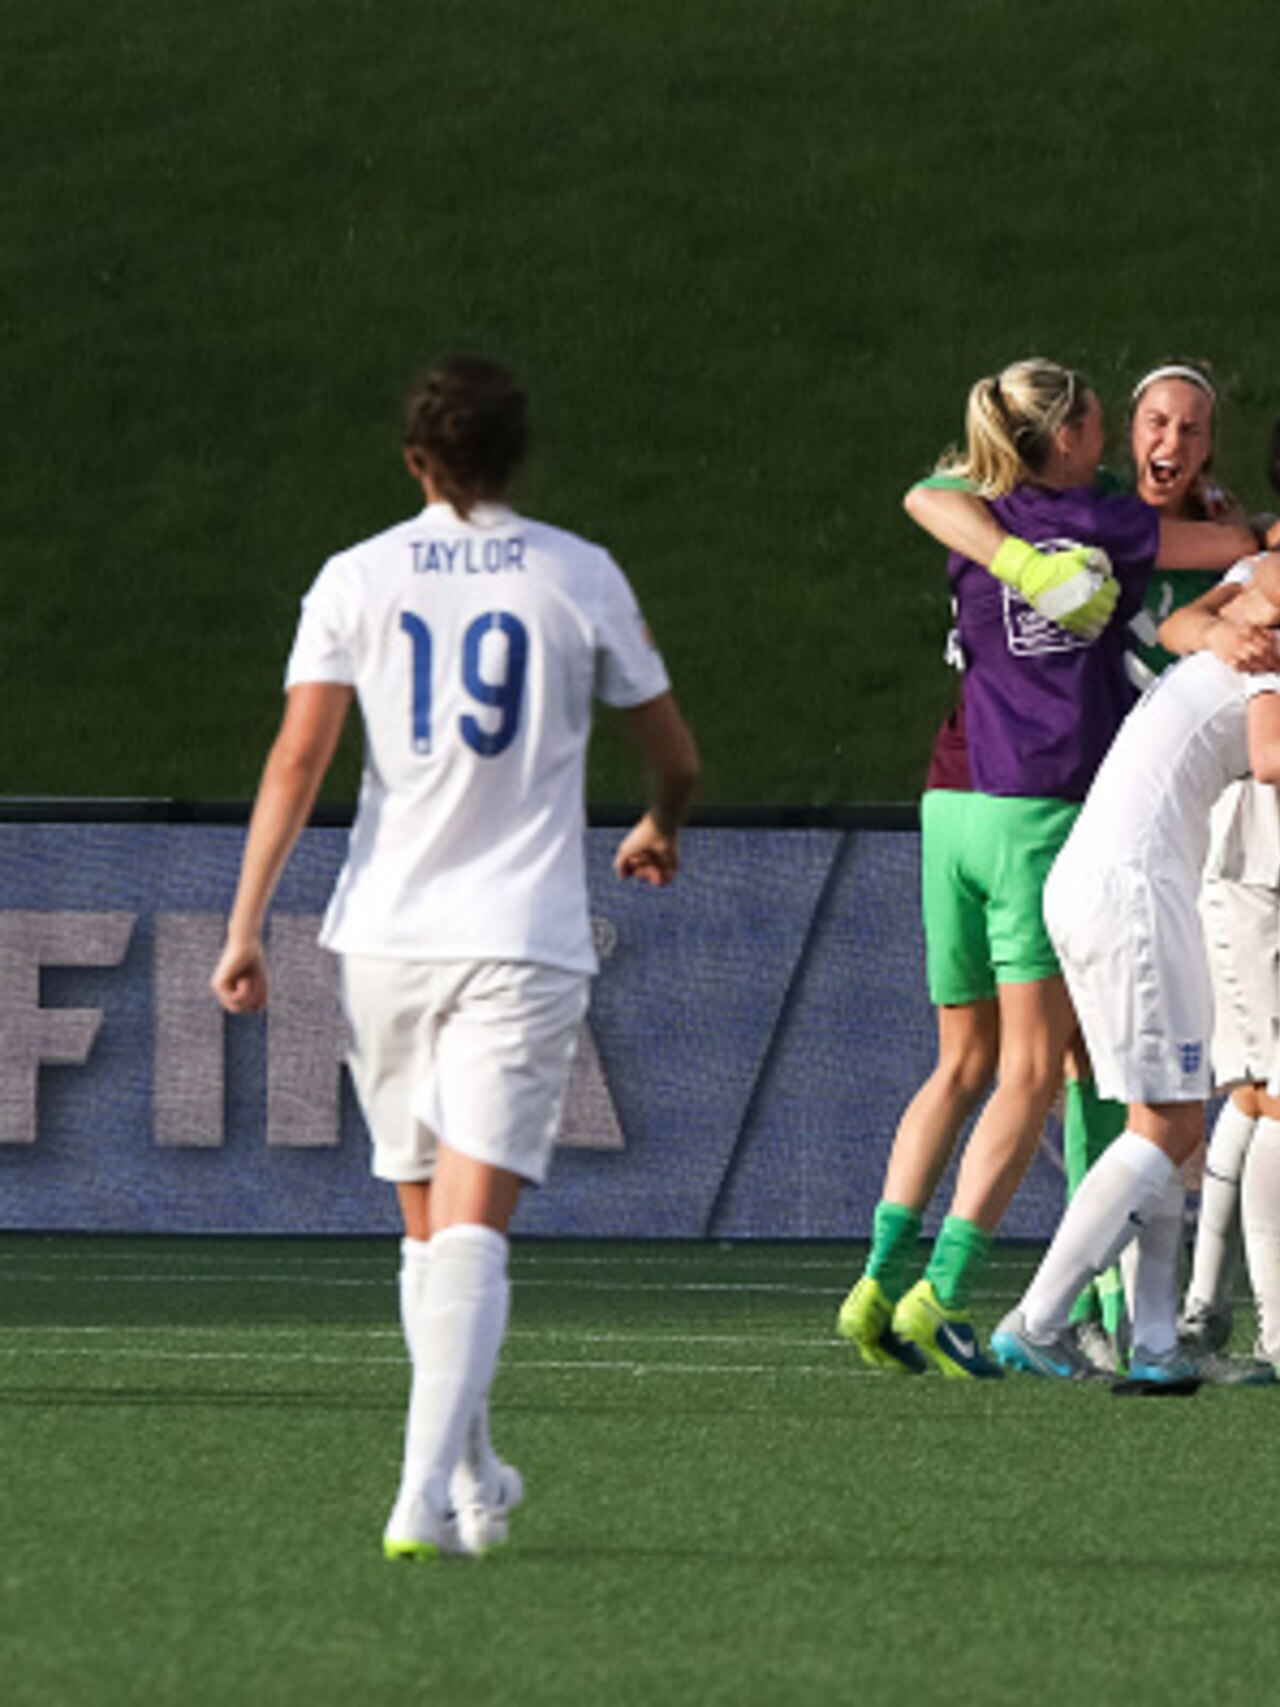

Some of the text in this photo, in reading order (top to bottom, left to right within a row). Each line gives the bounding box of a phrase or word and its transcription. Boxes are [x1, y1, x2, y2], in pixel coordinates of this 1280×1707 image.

[410, 537, 528, 574] TAYLOR
[400, 610, 529, 758] 19
[0, 911, 625, 1149] FIF
